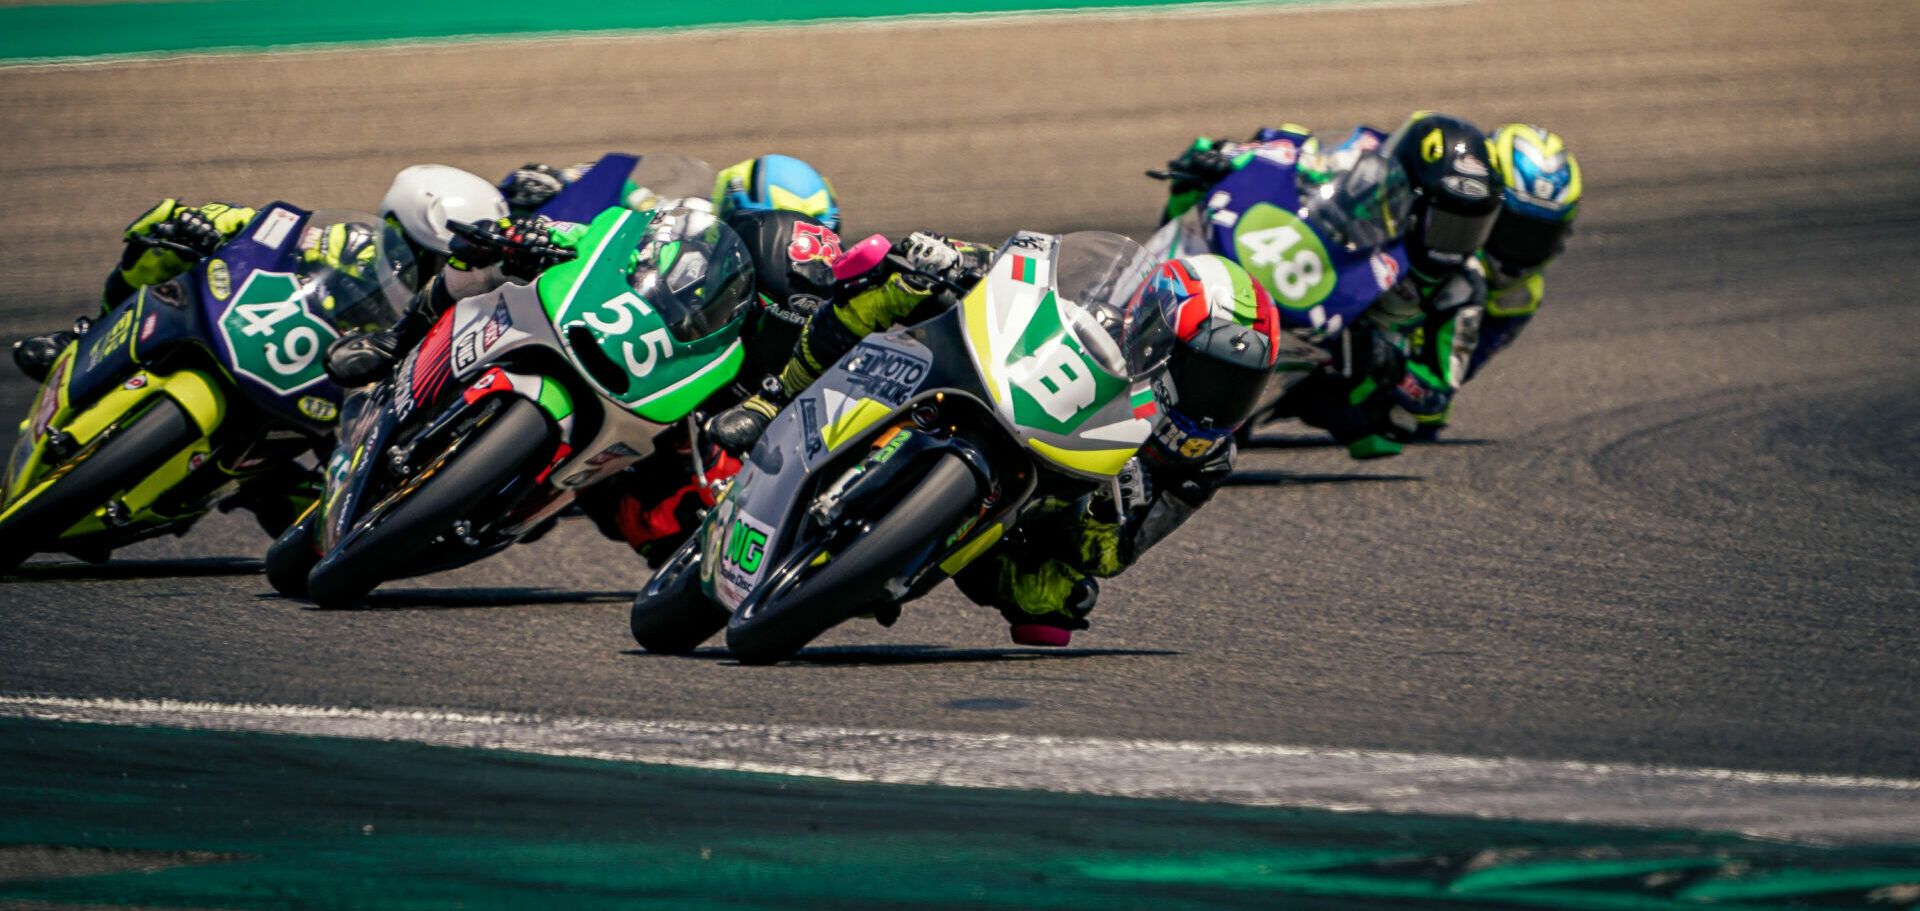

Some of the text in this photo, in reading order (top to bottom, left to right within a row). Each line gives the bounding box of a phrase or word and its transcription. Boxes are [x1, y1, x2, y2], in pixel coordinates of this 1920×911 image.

[1237, 225, 1324, 300] 48
[235, 301, 320, 376] 49
[583, 291, 674, 378] 55
[1013, 341, 1097, 423] 8
[725, 519, 769, 575] NG
